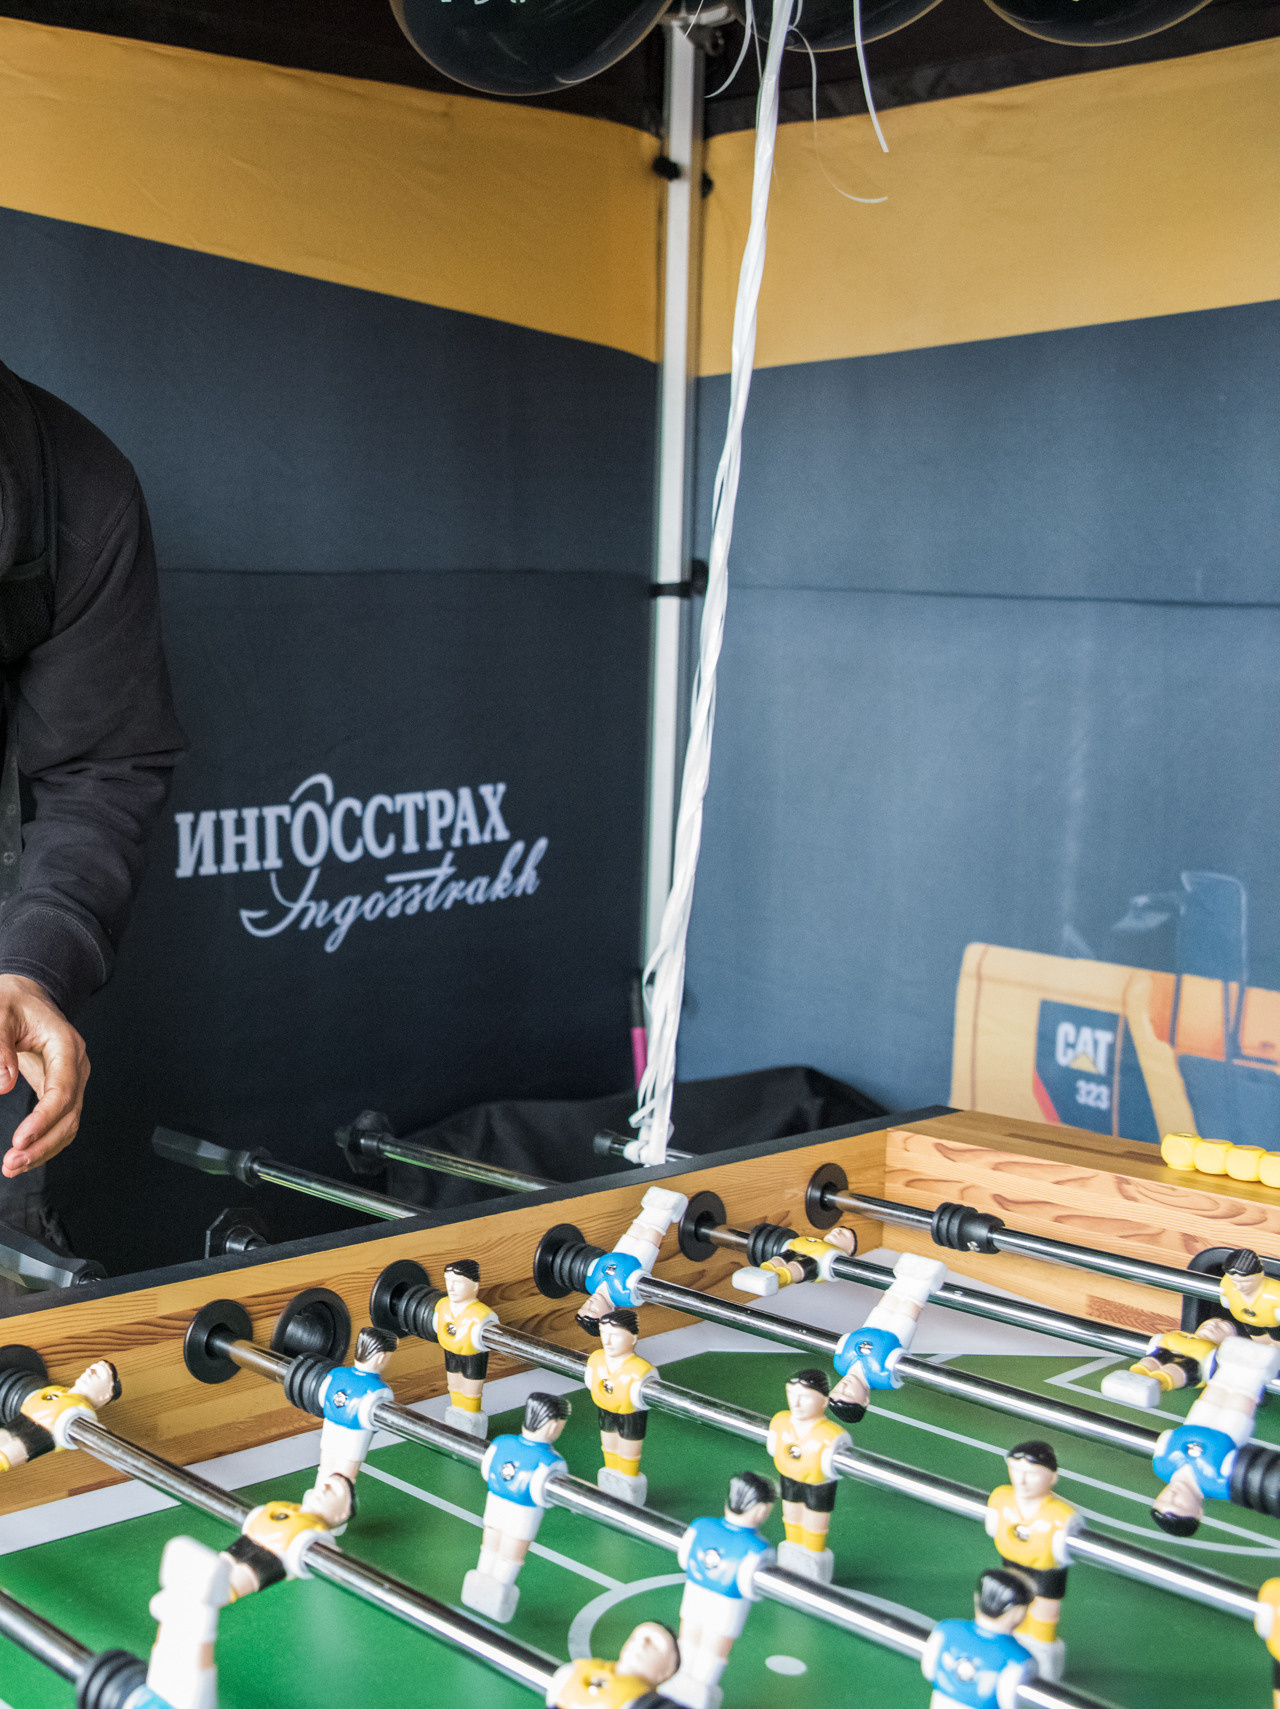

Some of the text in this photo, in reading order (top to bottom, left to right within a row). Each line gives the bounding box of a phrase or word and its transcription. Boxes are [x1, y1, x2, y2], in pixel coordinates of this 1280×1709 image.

[175, 779, 511, 879] ИНГОССТРАХ
[239, 836, 549, 953] Ingosstrakh
[1055, 1021, 1115, 1076] CAT
[1076, 1079, 1110, 1110] 323
